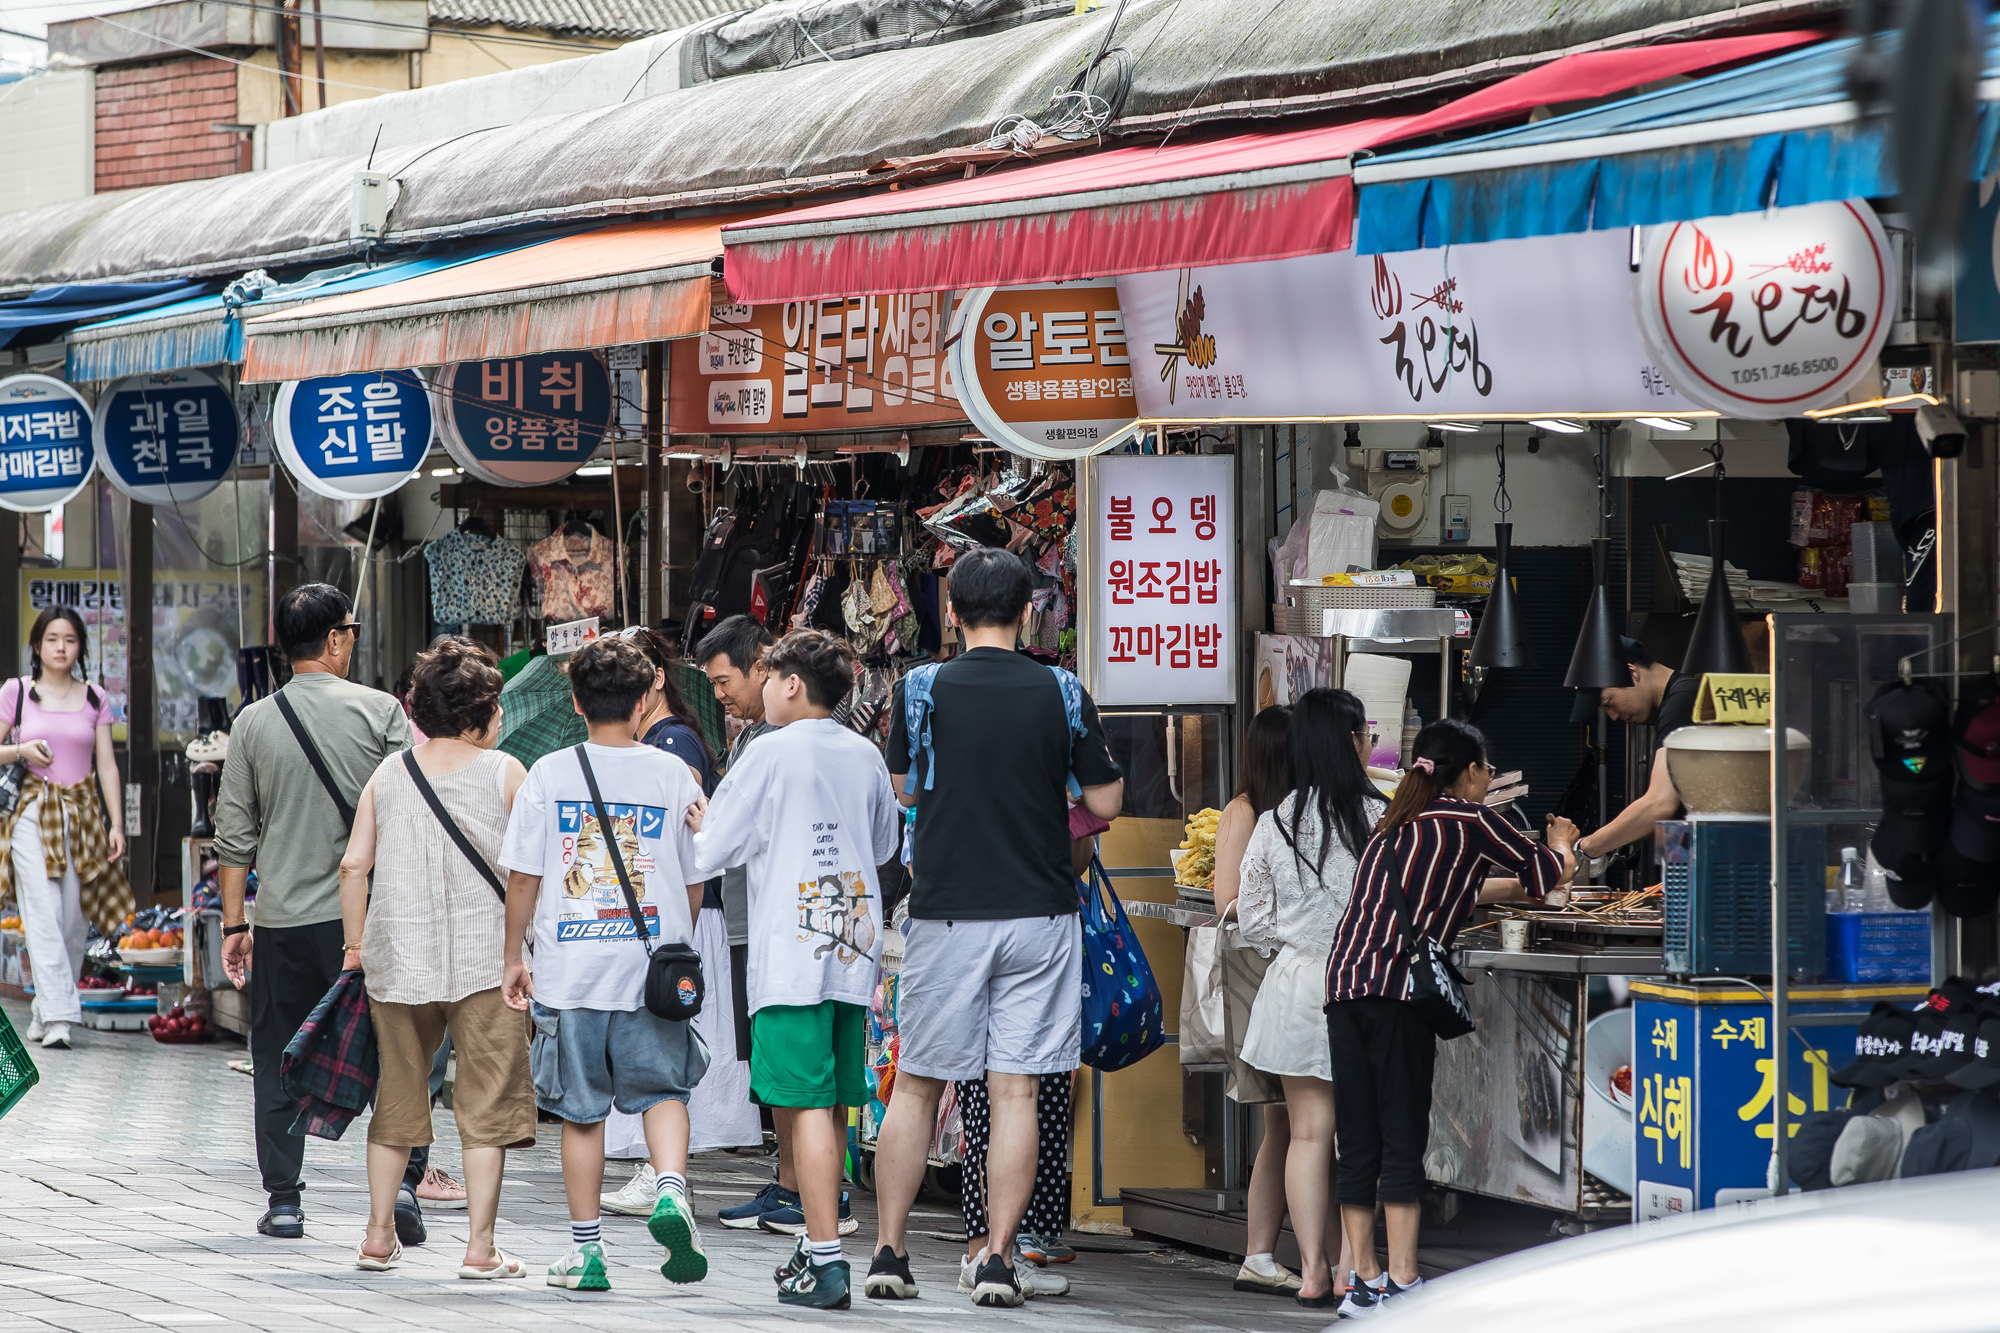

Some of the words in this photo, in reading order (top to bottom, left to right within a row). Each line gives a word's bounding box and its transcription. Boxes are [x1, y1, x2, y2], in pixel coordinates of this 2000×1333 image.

[728, 337, 741, 366] 부산
[1185, 374, 1207, 399] 맛있게
[1207, 374, 1222, 399] 맵다
[1731, 356, 1839, 385] T.051.746.8500
[318, 381, 402, 423] 조은
[737, 388, 751, 416] 지역
[753, 387, 766, 416] 밀착
[1005, 377, 1135, 401] 생활용품할인점
[0, 409, 81, 444] 지국밥
[129, 398, 210, 434] 과일
[319, 423, 406, 466] 신발
[485, 417, 579, 451] 양품점
[1045, 427, 1098, 440] 생활편의점
[132, 436, 213, 474] 천국
[1107, 559, 1222, 604] 원조김밥
[1107, 623, 1222, 668] 꼬마김밥
[597, 909, 622, 920] URBAN
[1652, 1018, 1677, 1061] 수제
[1711, 1017, 1766, 1049] 수제
[1639, 1073, 1691, 1170] 식혜
